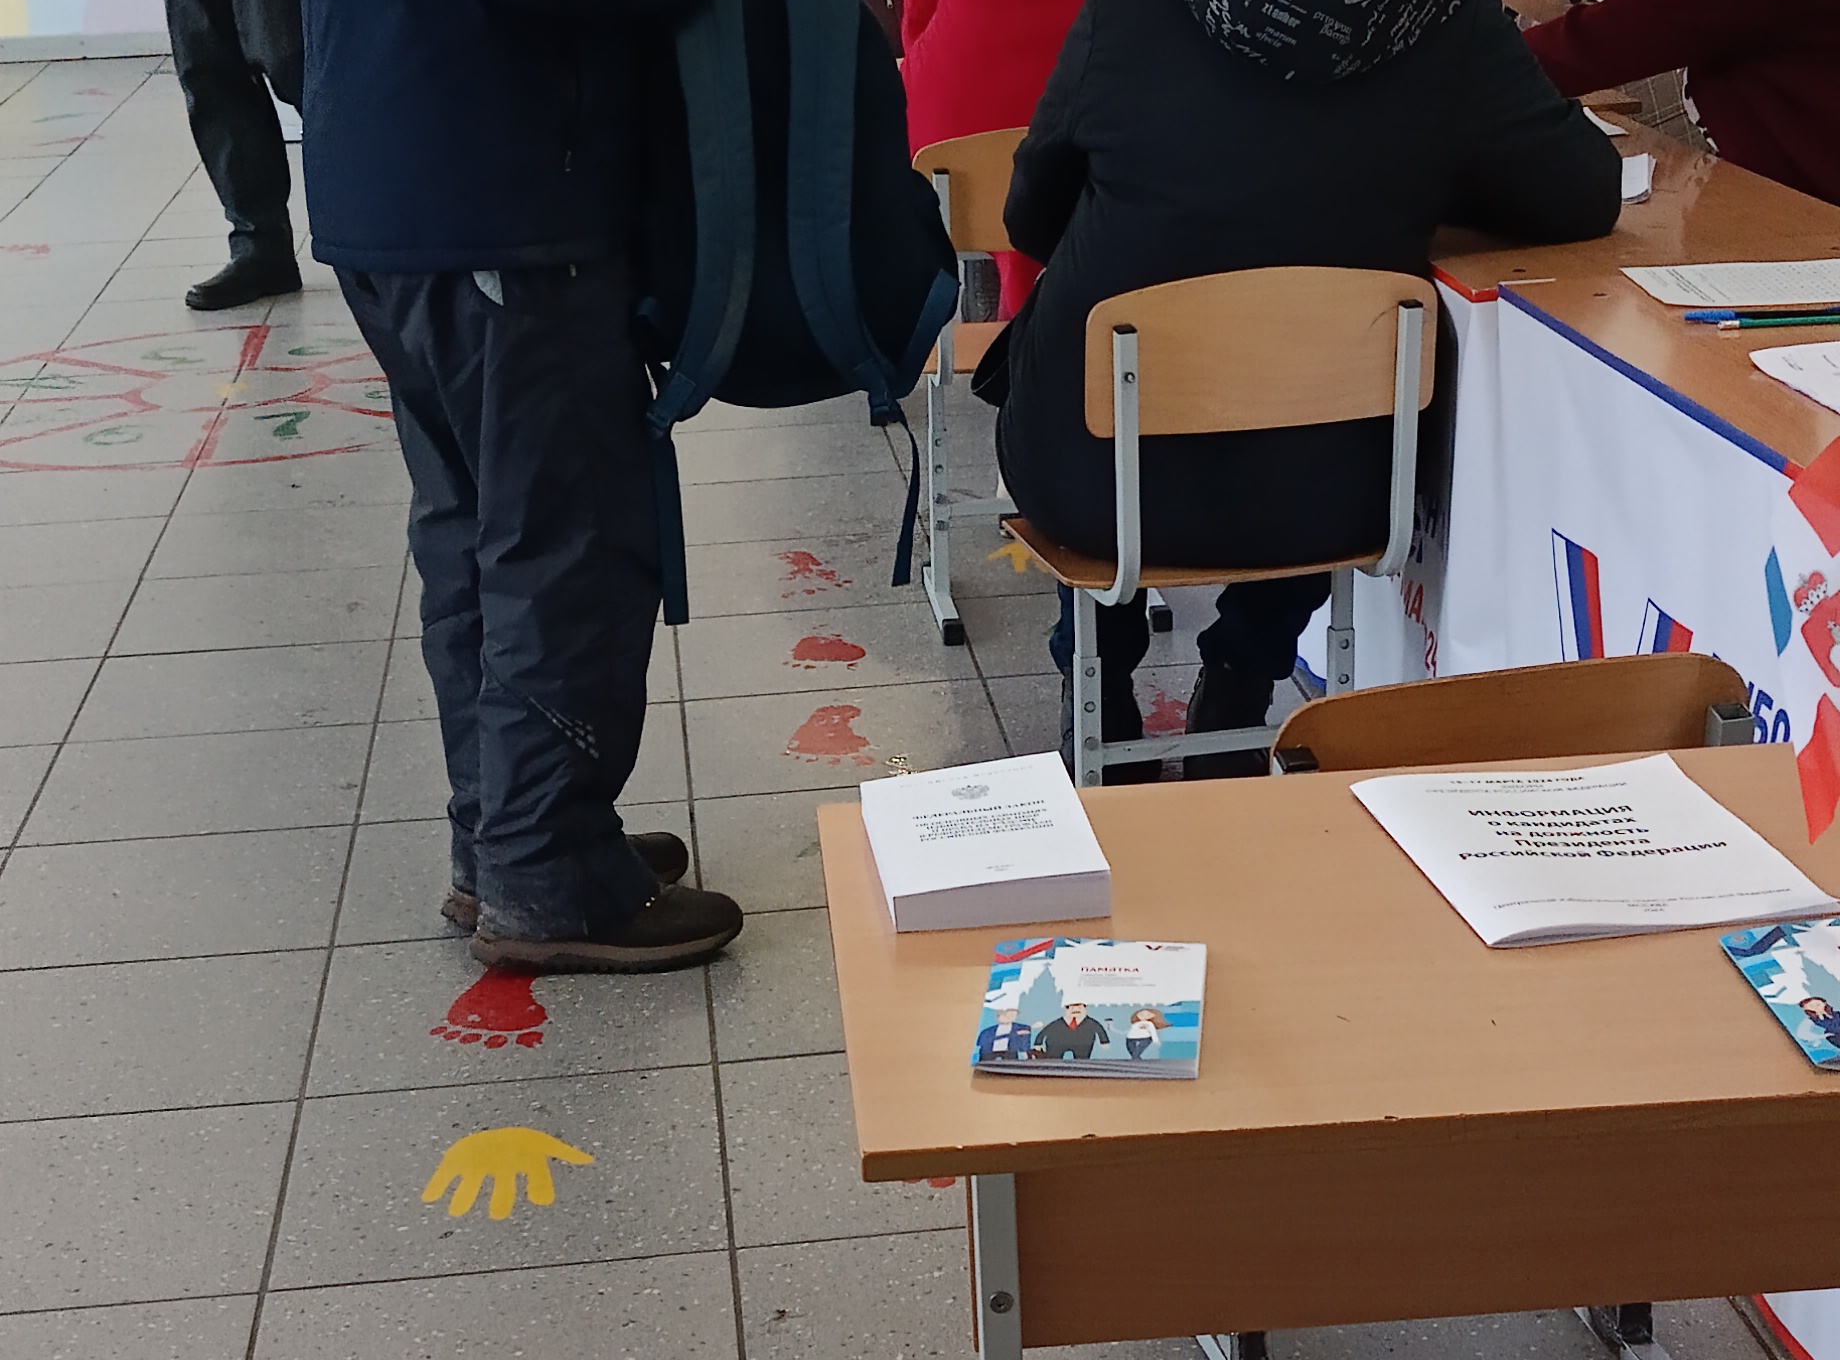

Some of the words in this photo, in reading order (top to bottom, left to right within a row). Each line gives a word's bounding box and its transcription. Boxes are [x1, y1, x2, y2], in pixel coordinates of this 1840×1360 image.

[1468, 805, 1634, 818] ИНФОРМАЦИЯ
[1506, 816, 1637, 828] кандидатах
[1528, 827, 1650, 839] должность
[1514, 838, 1651, 848] Президента
[1596, 841, 1728, 858] Федерации
